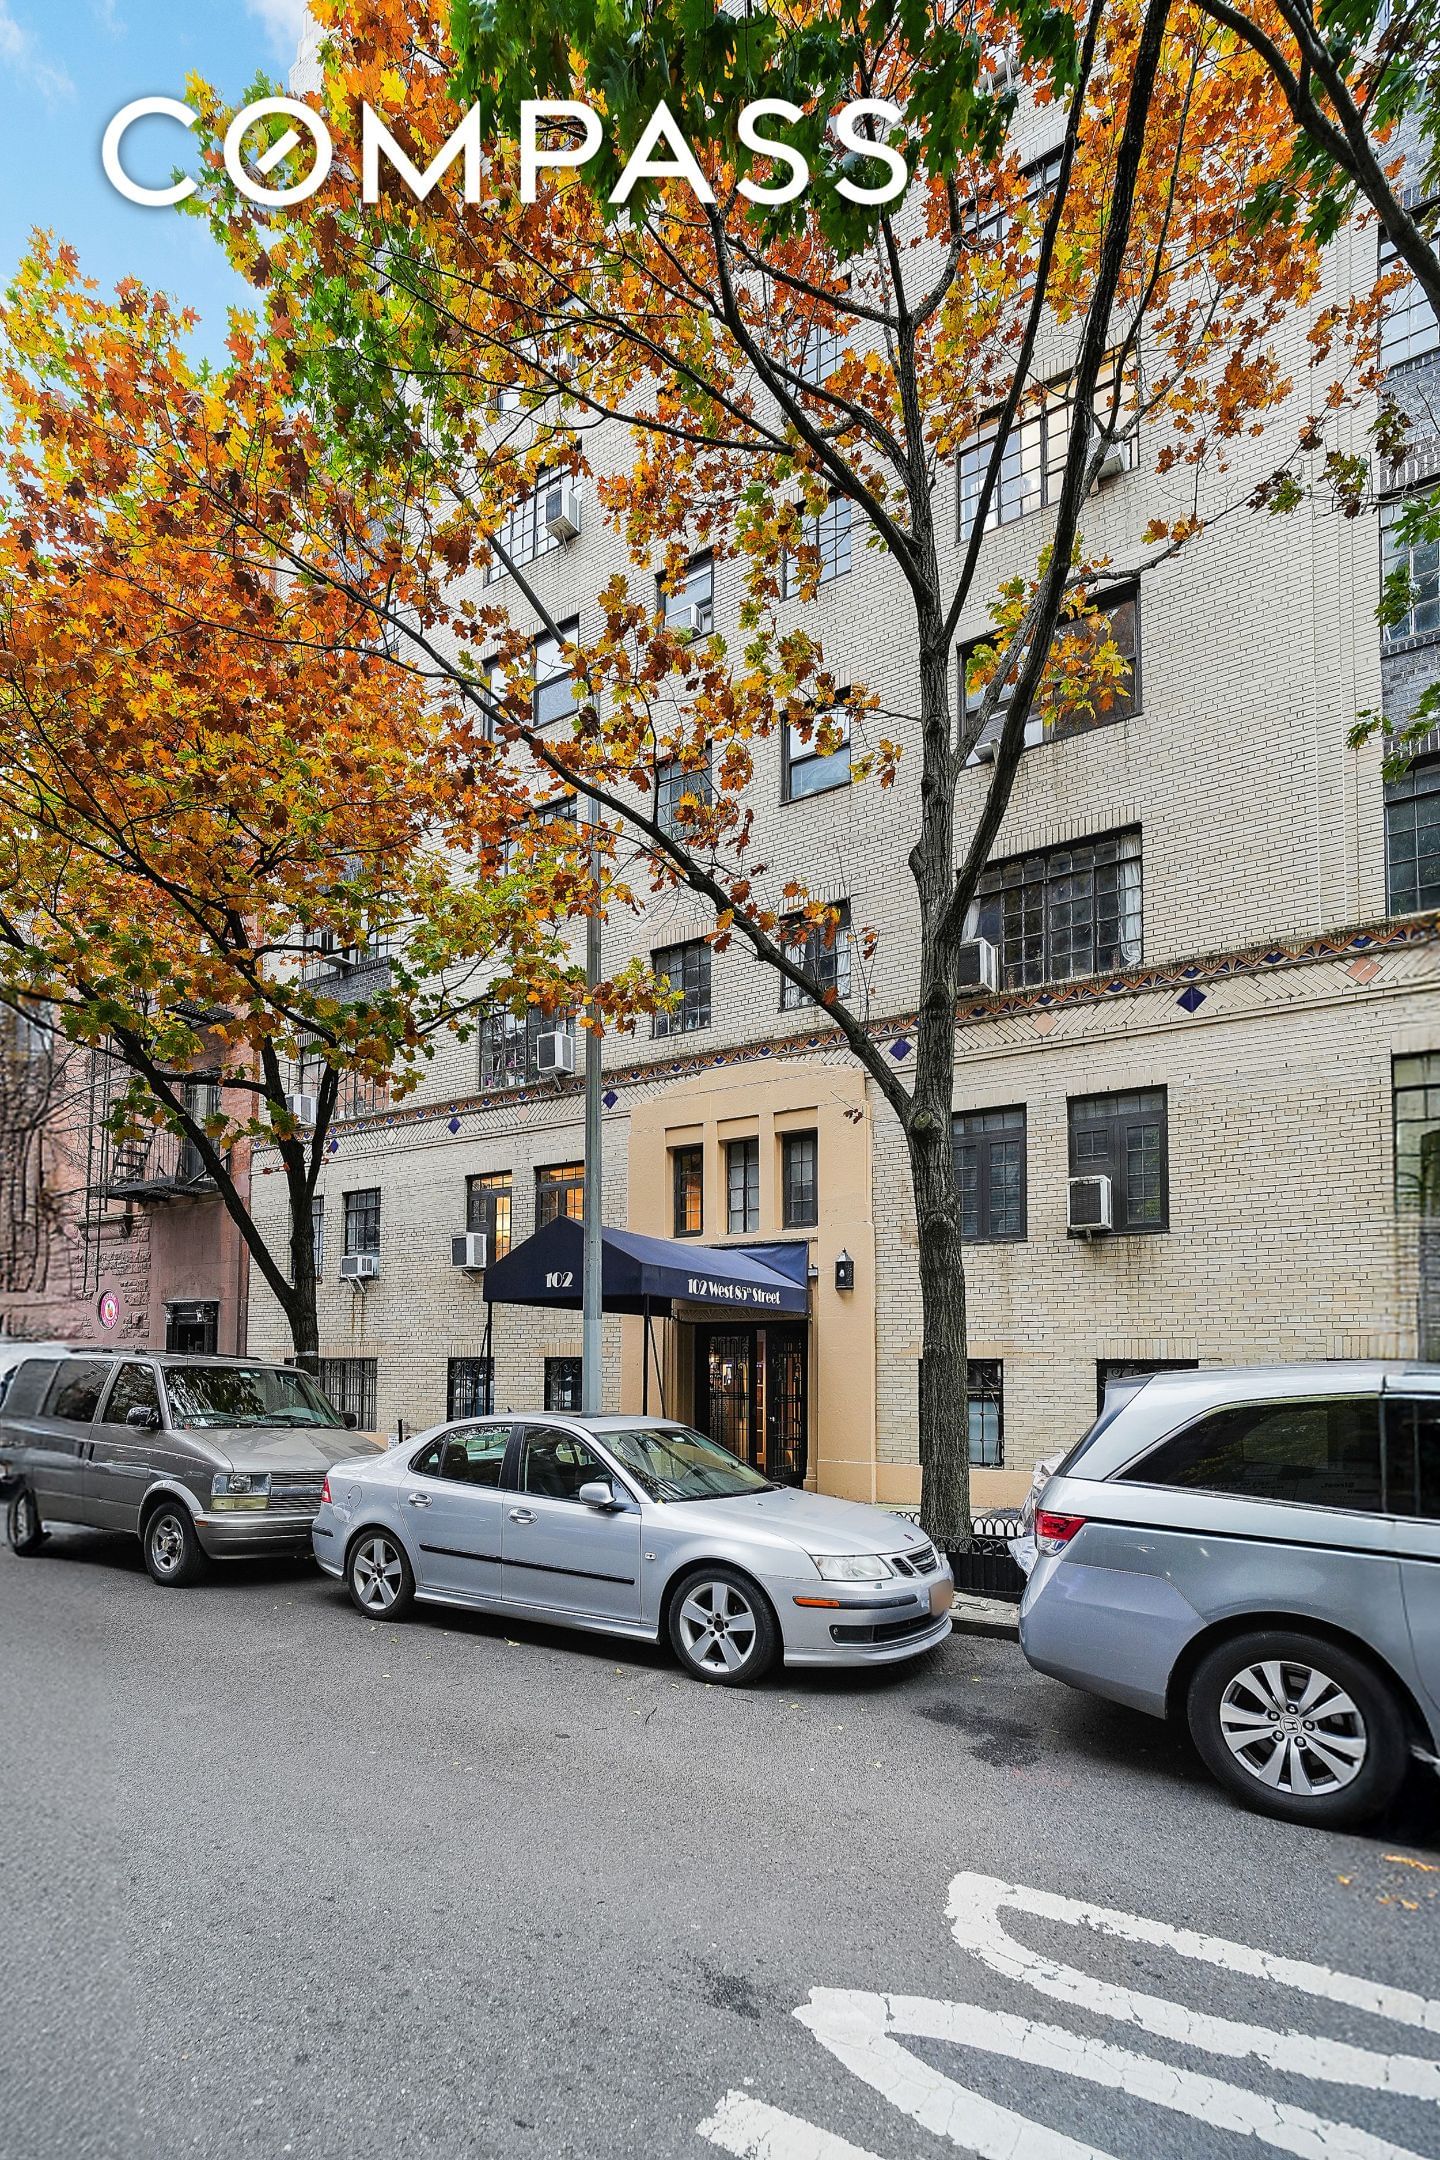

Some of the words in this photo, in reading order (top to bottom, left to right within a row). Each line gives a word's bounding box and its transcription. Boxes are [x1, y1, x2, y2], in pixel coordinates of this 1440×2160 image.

[545, 1271, 573, 1288] 102
[688, 1278, 708, 1296] 102
[708, 1281, 734, 1299] West
[752, 1287, 781, 1305] Street
